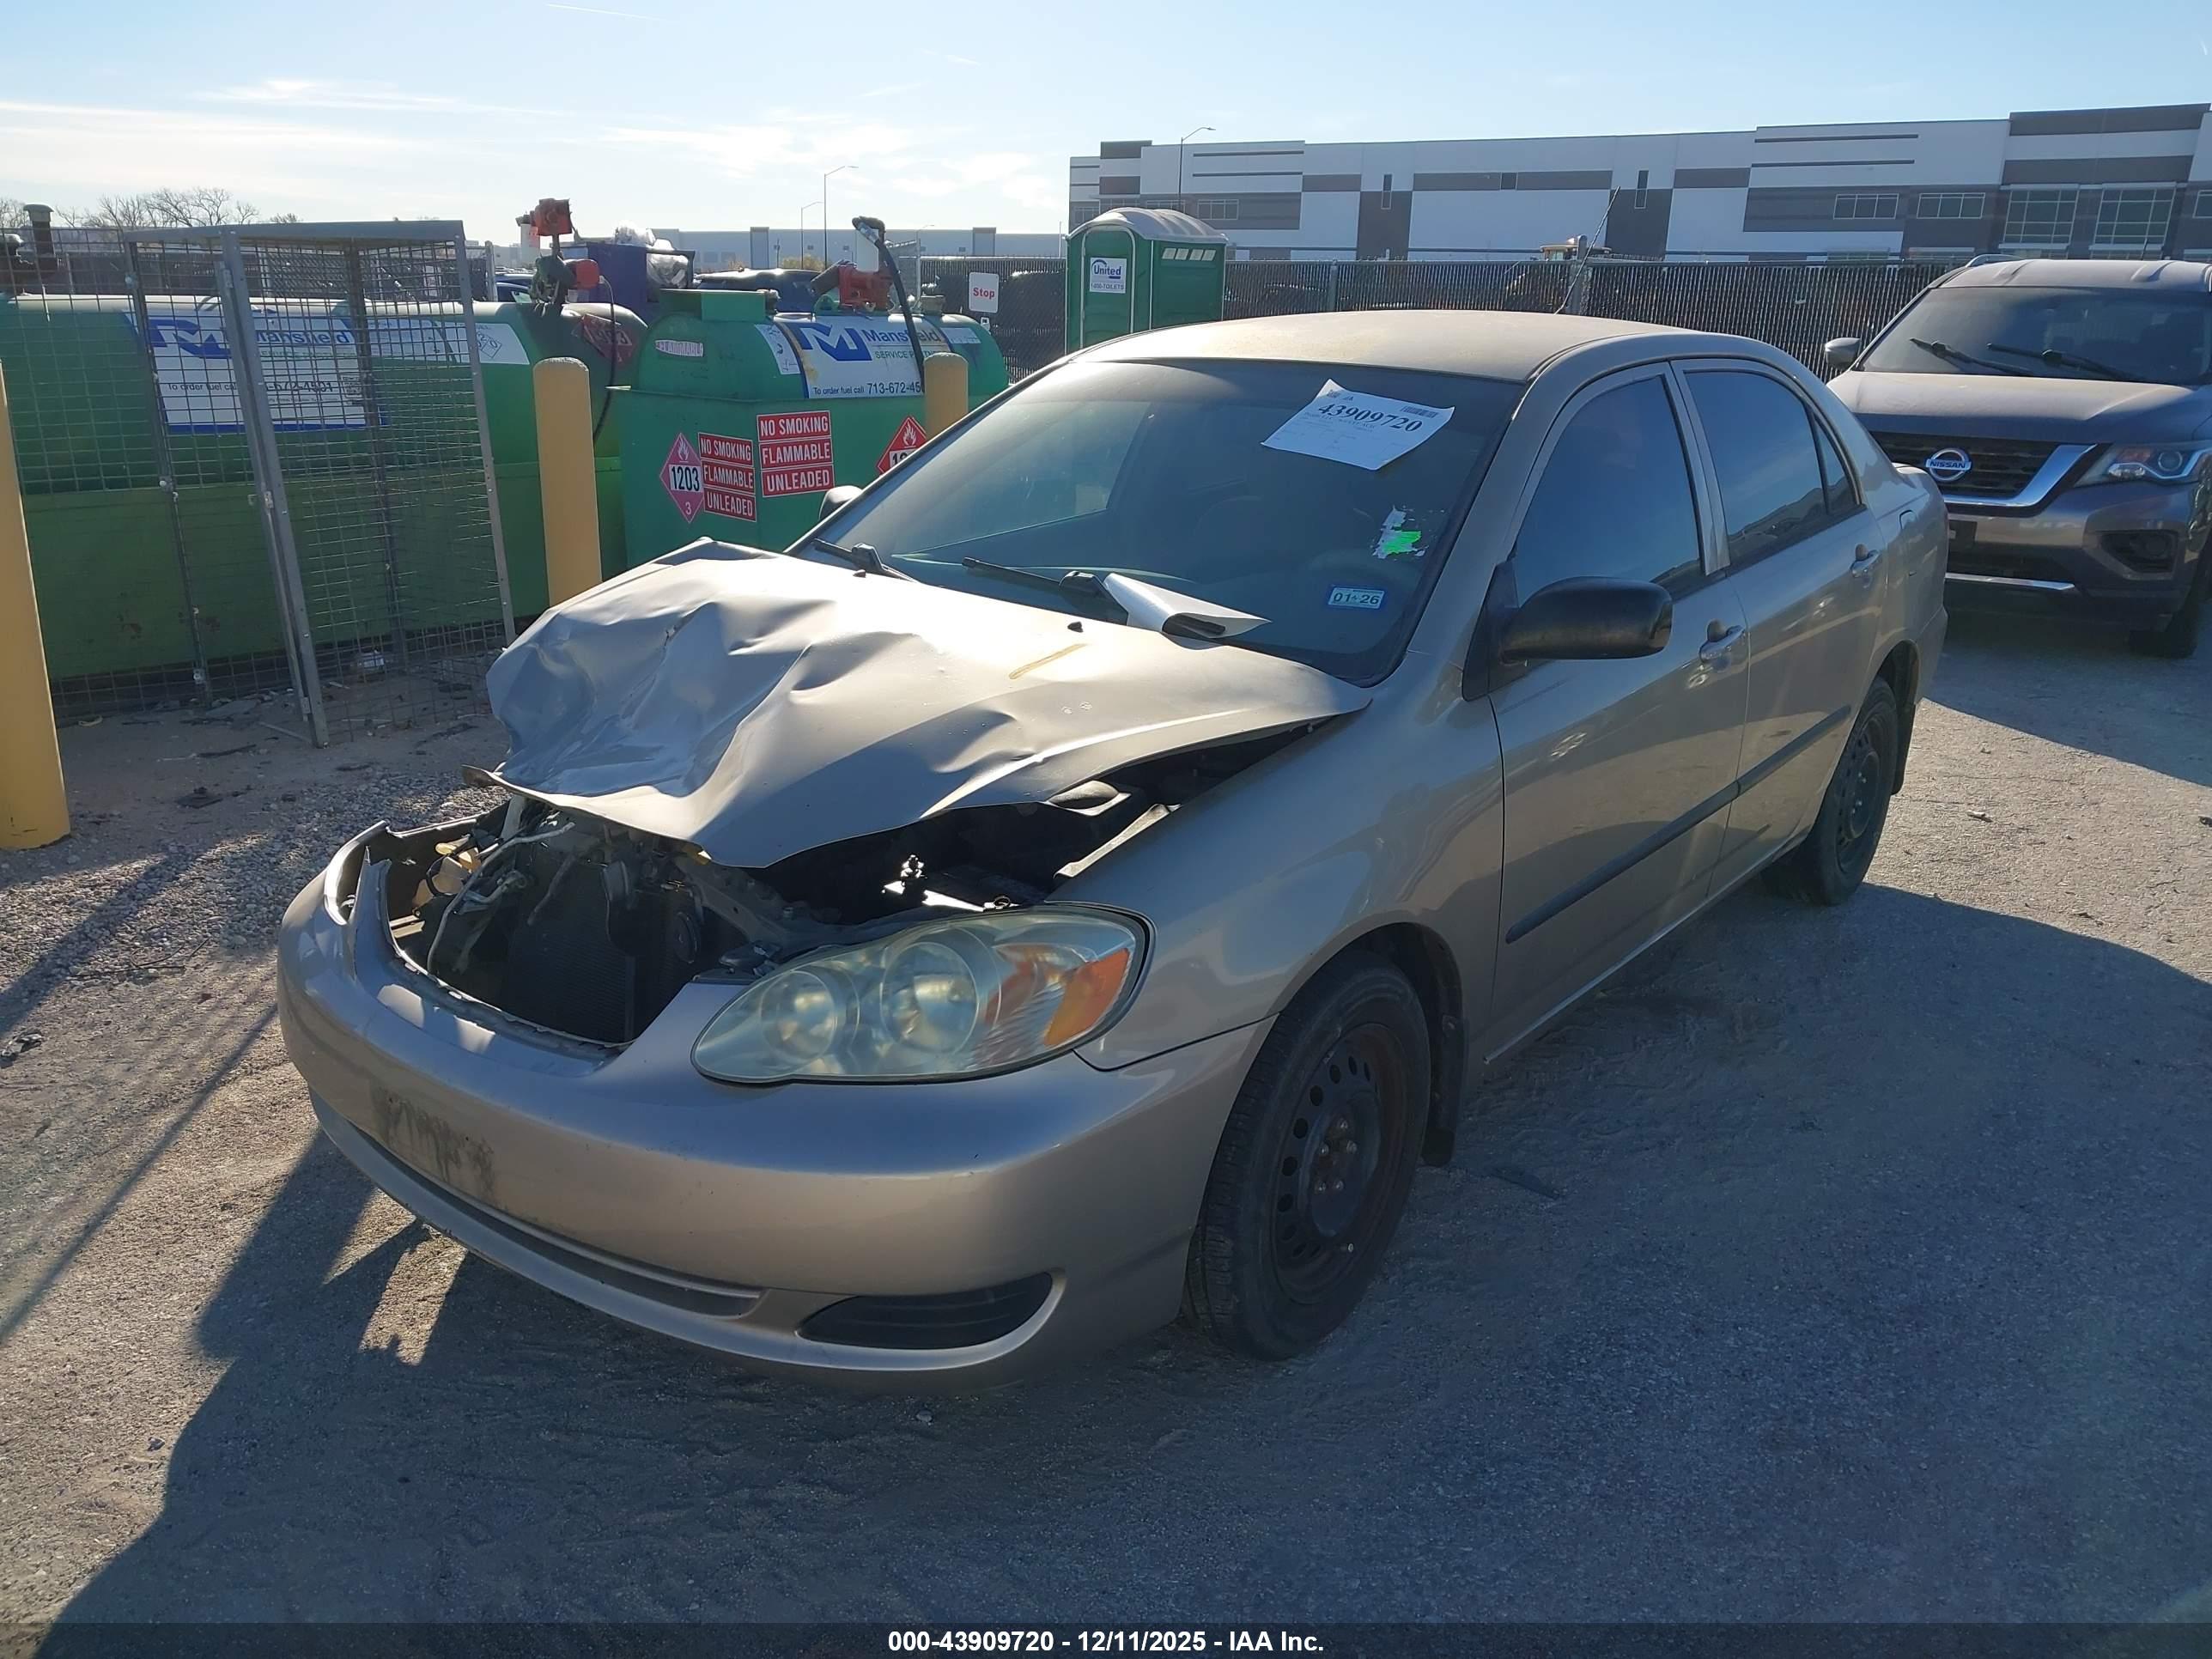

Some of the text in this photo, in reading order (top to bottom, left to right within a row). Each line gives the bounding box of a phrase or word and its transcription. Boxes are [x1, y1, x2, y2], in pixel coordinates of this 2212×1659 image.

[1094, 264, 1121, 276] United
[973, 287, 995, 300] Stop
[875, 349, 904, 359] SERVICE
[813, 386, 822, 395] To
[841, 386, 853, 394] fuel
[854, 386, 865, 394] call
[760, 416, 829, 437] NO SMOKING
[1318, 404, 1424, 432] 43909720
[701, 437, 751, 462] NO SMOKING
[762, 441, 831, 465] FLAMMABLE
[671, 465, 700, 492] 1203
[703, 464, 754, 489] FLAMMABLE
[766, 469, 830, 492] UNLEADED
[684, 501, 692, 515] 3
[707, 491, 753, 517] UNLEADED
[1334, 592, 1352, 603] 01
[1359, 594, 1380, 605] 26
